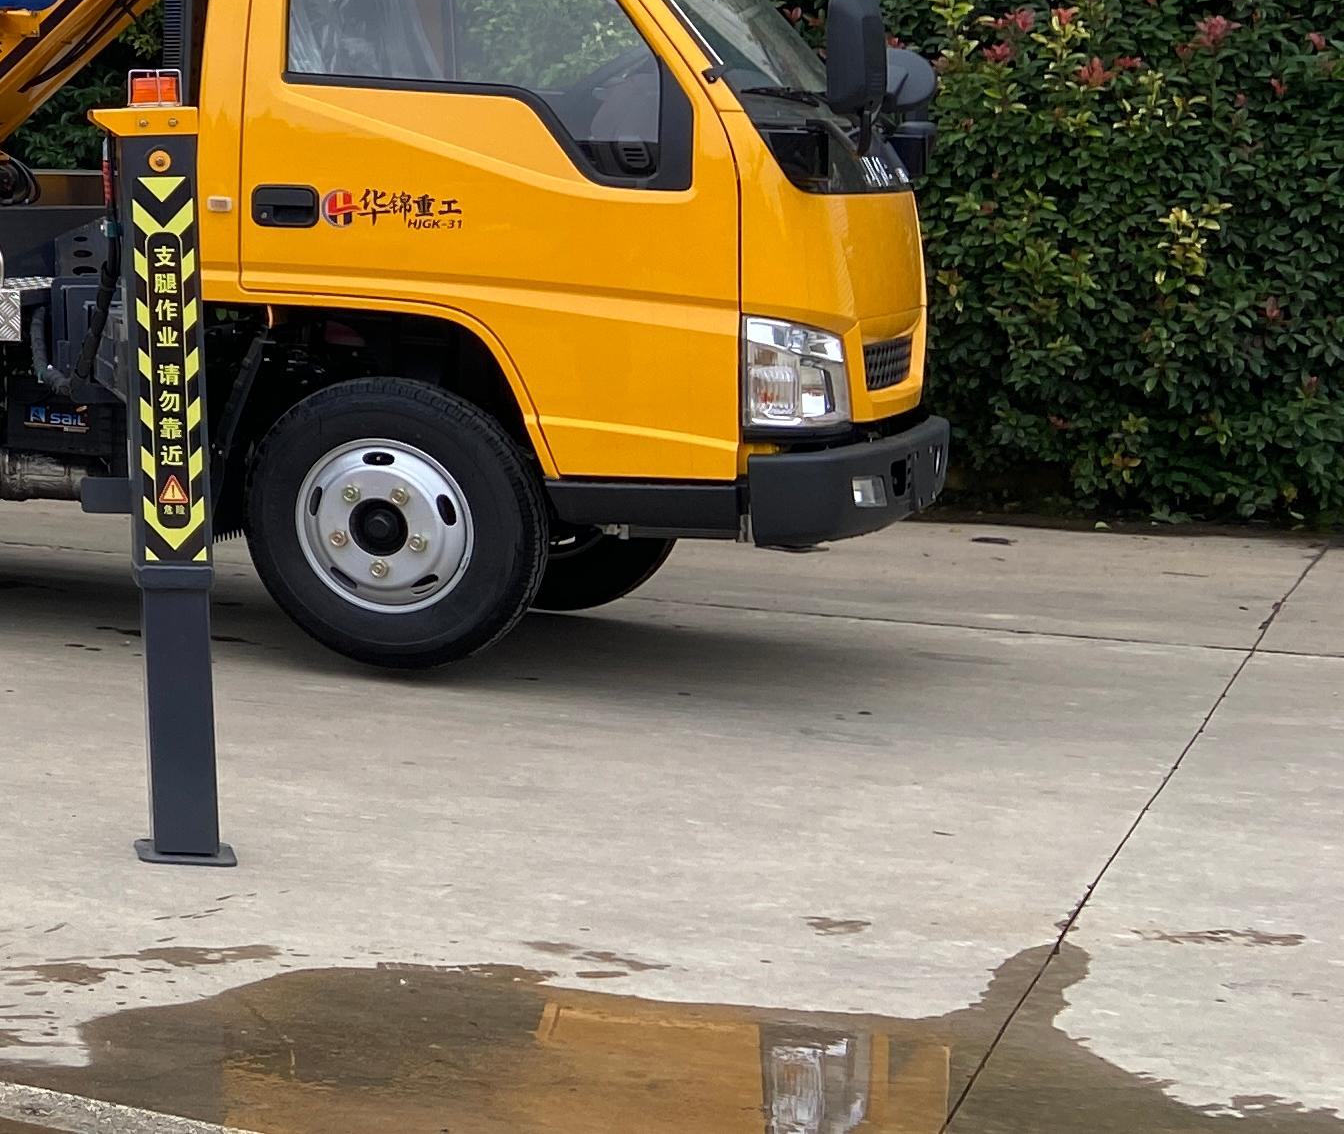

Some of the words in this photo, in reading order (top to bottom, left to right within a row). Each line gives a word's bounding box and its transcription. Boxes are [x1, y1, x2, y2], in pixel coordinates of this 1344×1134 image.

[357, 188, 462, 226] 华锦重工
[407, 218, 463, 229] HJGK-31
[153, 245, 180, 348] 支腿作业
[156, 363, 184, 467] 请勿靠近
[163, 504, 186, 516] 危险
